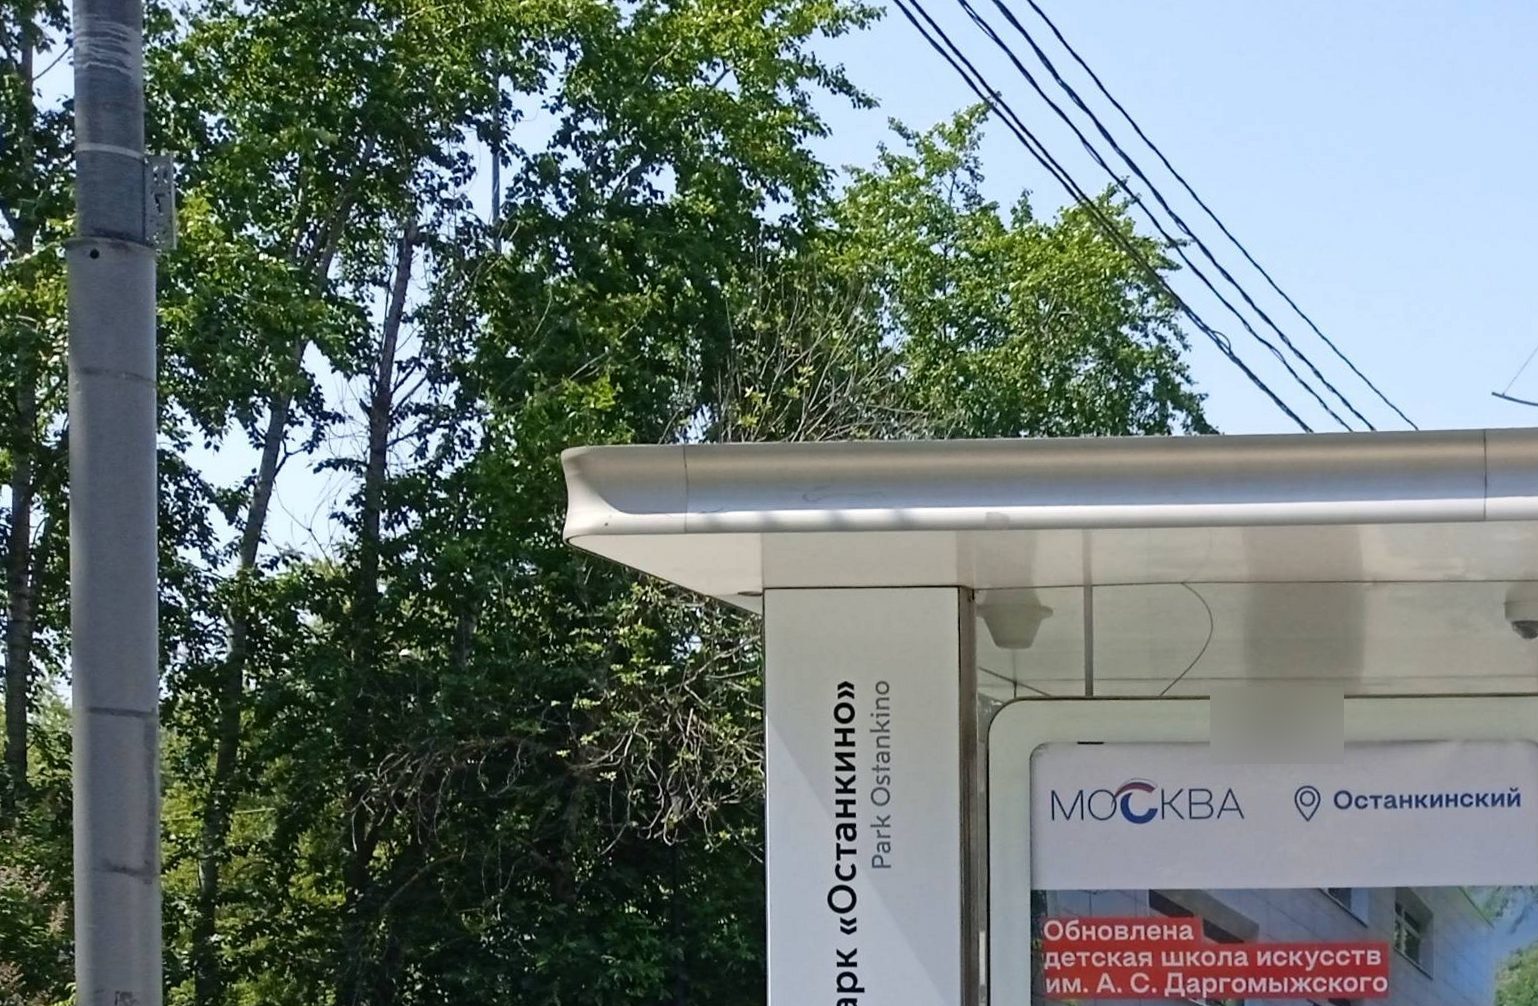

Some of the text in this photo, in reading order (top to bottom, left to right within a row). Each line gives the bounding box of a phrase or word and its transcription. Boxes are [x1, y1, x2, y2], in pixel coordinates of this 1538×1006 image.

[870, 680, 892, 869] Park Ostankino
[827, 680, 858, 936] «Останкино»
[1050, 778, 1245, 824] МОСКВА
[1333, 787, 1521, 810] Останкинский
[1043, 920, 1194, 941] Обновлена
[1044, 949, 1382, 971] детская школа искусств
[1046, 972, 1389, 998] им. А. С. Даргомыжского
